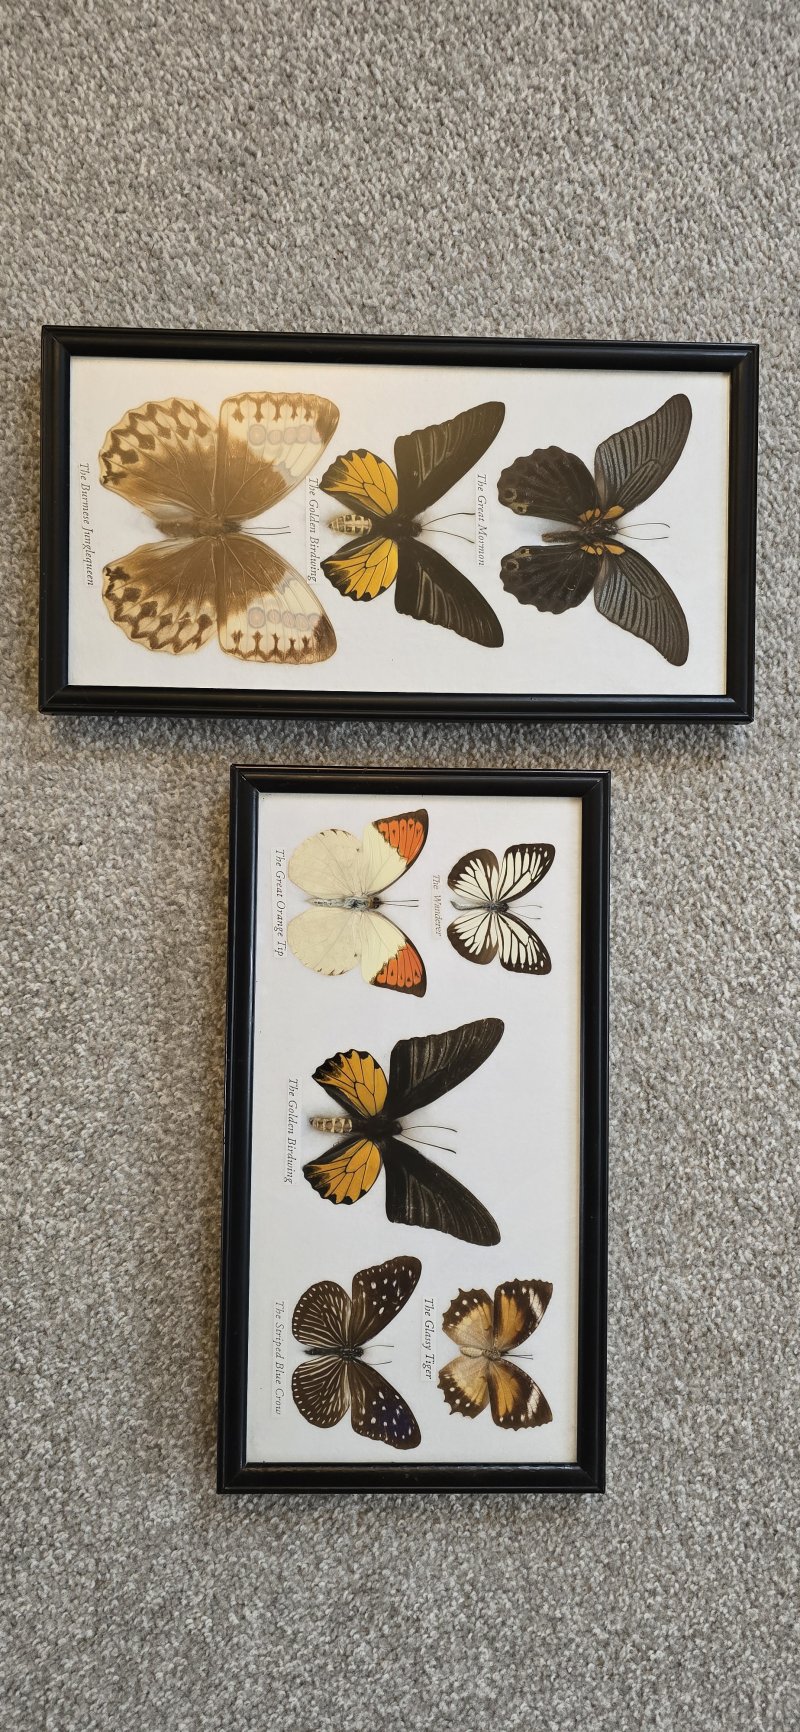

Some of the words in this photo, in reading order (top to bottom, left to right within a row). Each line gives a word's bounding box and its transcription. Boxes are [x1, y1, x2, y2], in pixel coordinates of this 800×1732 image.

[80, 463, 90, 481] The
[477, 474, 487, 491] The
[308, 478, 320, 496] The
[81, 483, 91, 525] Burmese
[308, 499, 320, 533] Golden
[477, 495, 487, 521] Great
[82, 526, 95, 586] Junglequeen
[477, 524, 488, 566] Mormon
[307, 536, 320, 582] Birdwing
[275, 849, 286, 867] The
[275, 870, 286, 897] Great
[433, 874, 441, 890] The
[273, 900, 286, 937] Orange
[433, 895, 443, 937] Wanderer
[274, 940, 287, 957] Tip
[288, 1078, 299, 1097] The
[287, 1100, 298, 1134] Golden
[283, 1137, 297, 1185] Birdwing
[275, 1301, 285, 1320] The
[424, 1298, 435, 1317] The
[272, 1321, 285, 1360] Striped
[422, 1319, 435, 1351] Glassy
[275, 1361, 285, 1385] Blue
[422, 1353, 435, 1380] Tiger
[275, 1388, 285, 1415] Crow
